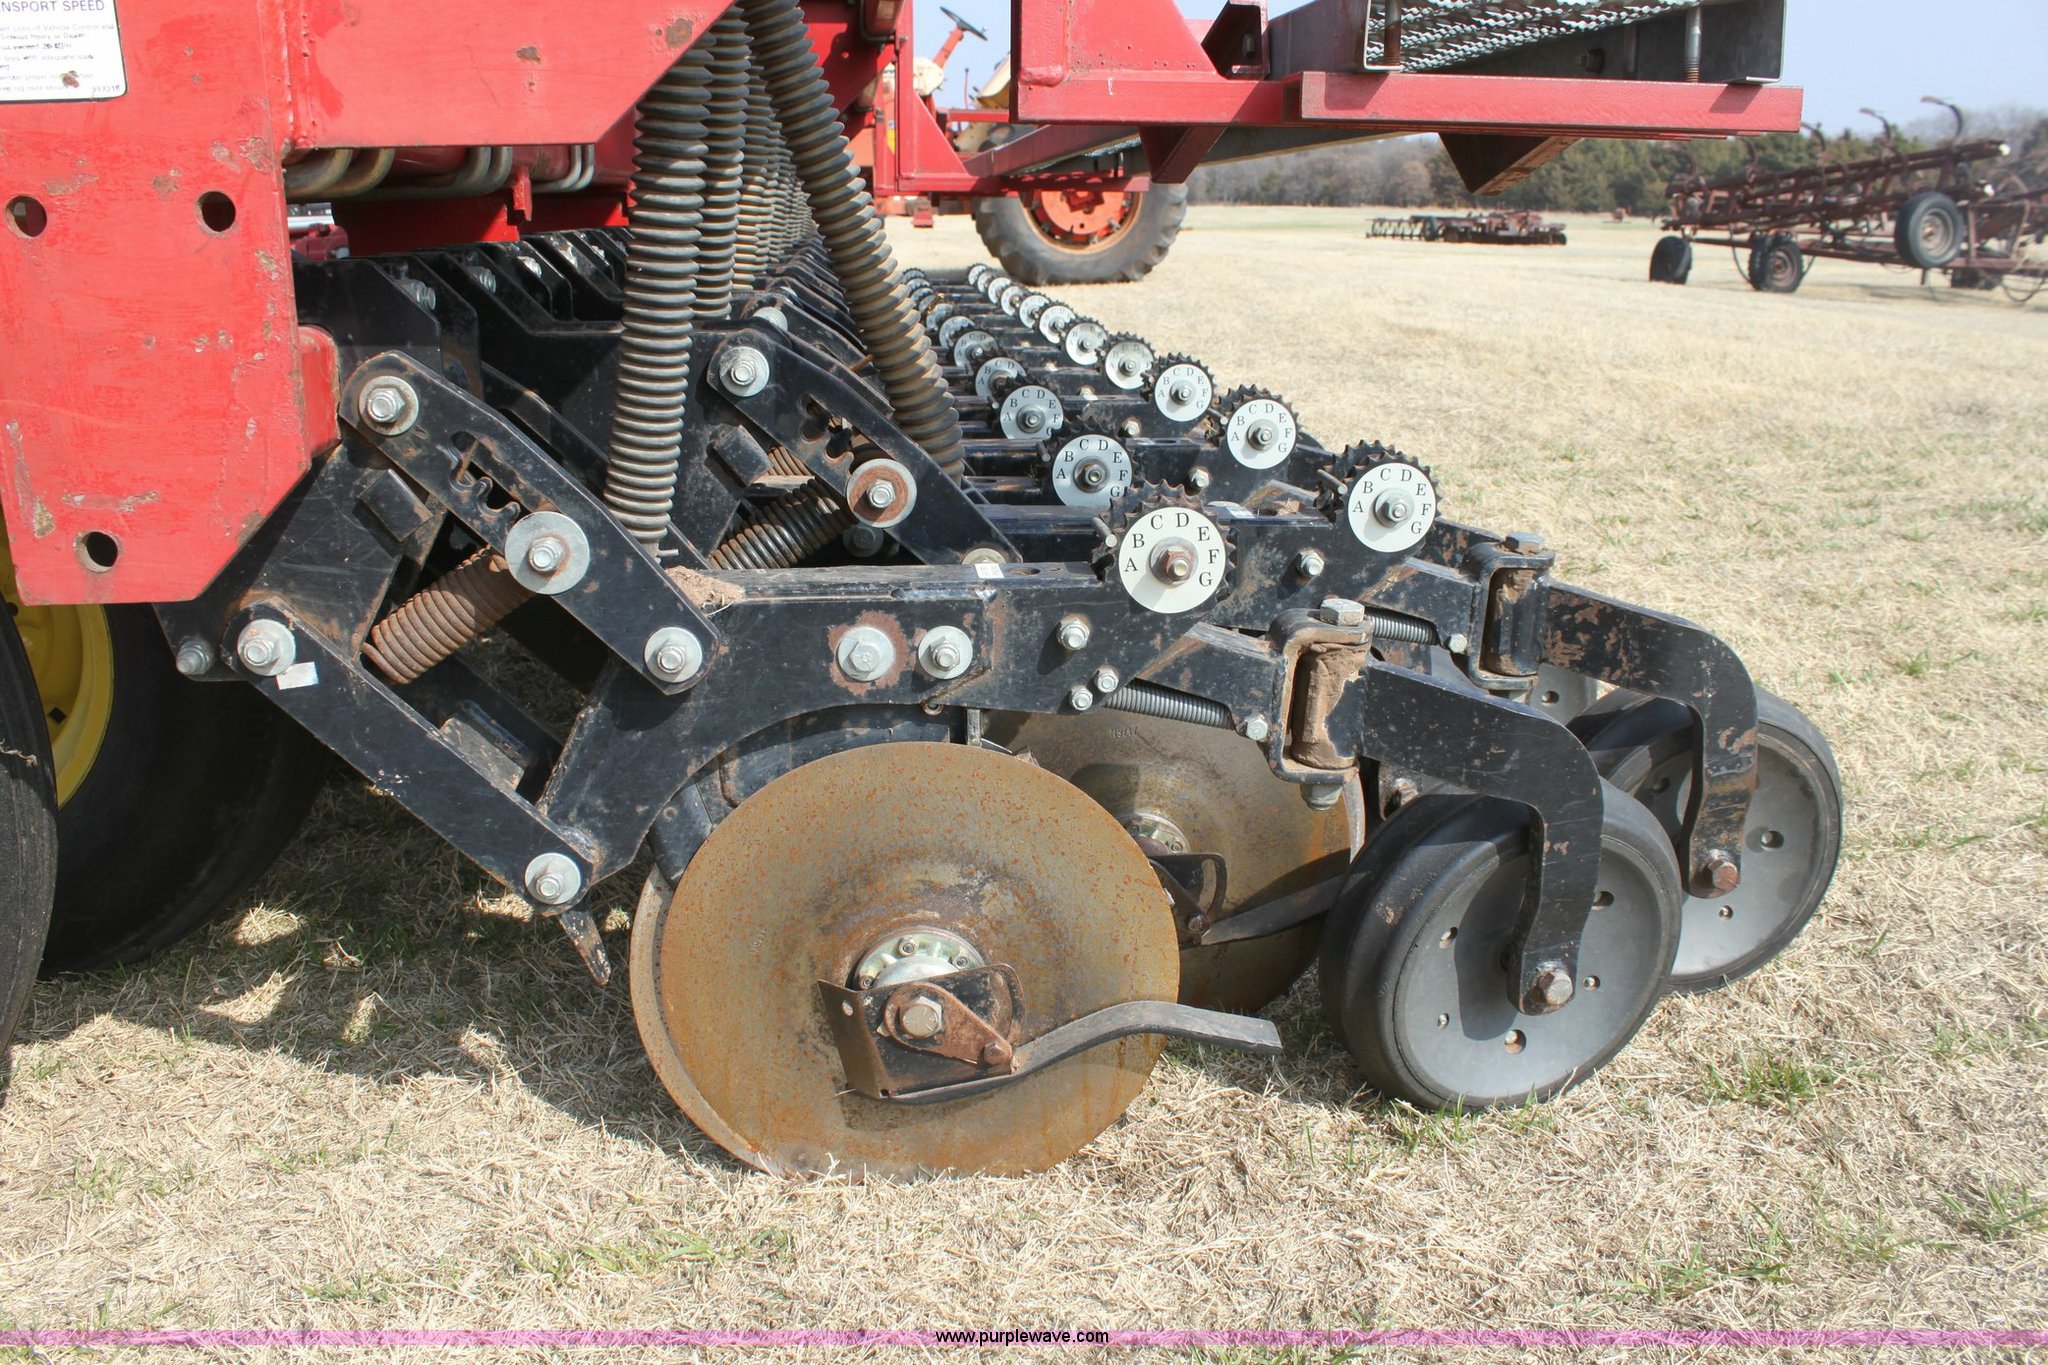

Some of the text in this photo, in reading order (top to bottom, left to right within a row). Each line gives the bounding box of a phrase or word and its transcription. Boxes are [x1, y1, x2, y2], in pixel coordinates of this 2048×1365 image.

[0, 0, 105, 12] NSPORT SPEED
[985, 366, 991, 374] B
[1007, 361, 1015, 369] D
[1158, 368, 1208, 409] A B C D E F G
[1004, 412, 1011, 421] A
[1010, 399, 1018, 407] B
[1022, 389, 1029, 398] C
[1037, 390, 1045, 398] D
[1049, 400, 1056, 409] E
[1053, 414, 1060, 423] F
[1231, 404, 1292, 453] A B C D E F G
[1056, 439, 1128, 497] A B C D E F G
[1353, 468, 1431, 534] A B C D E F G
[1124, 513, 1219, 587] A B C D E F G
